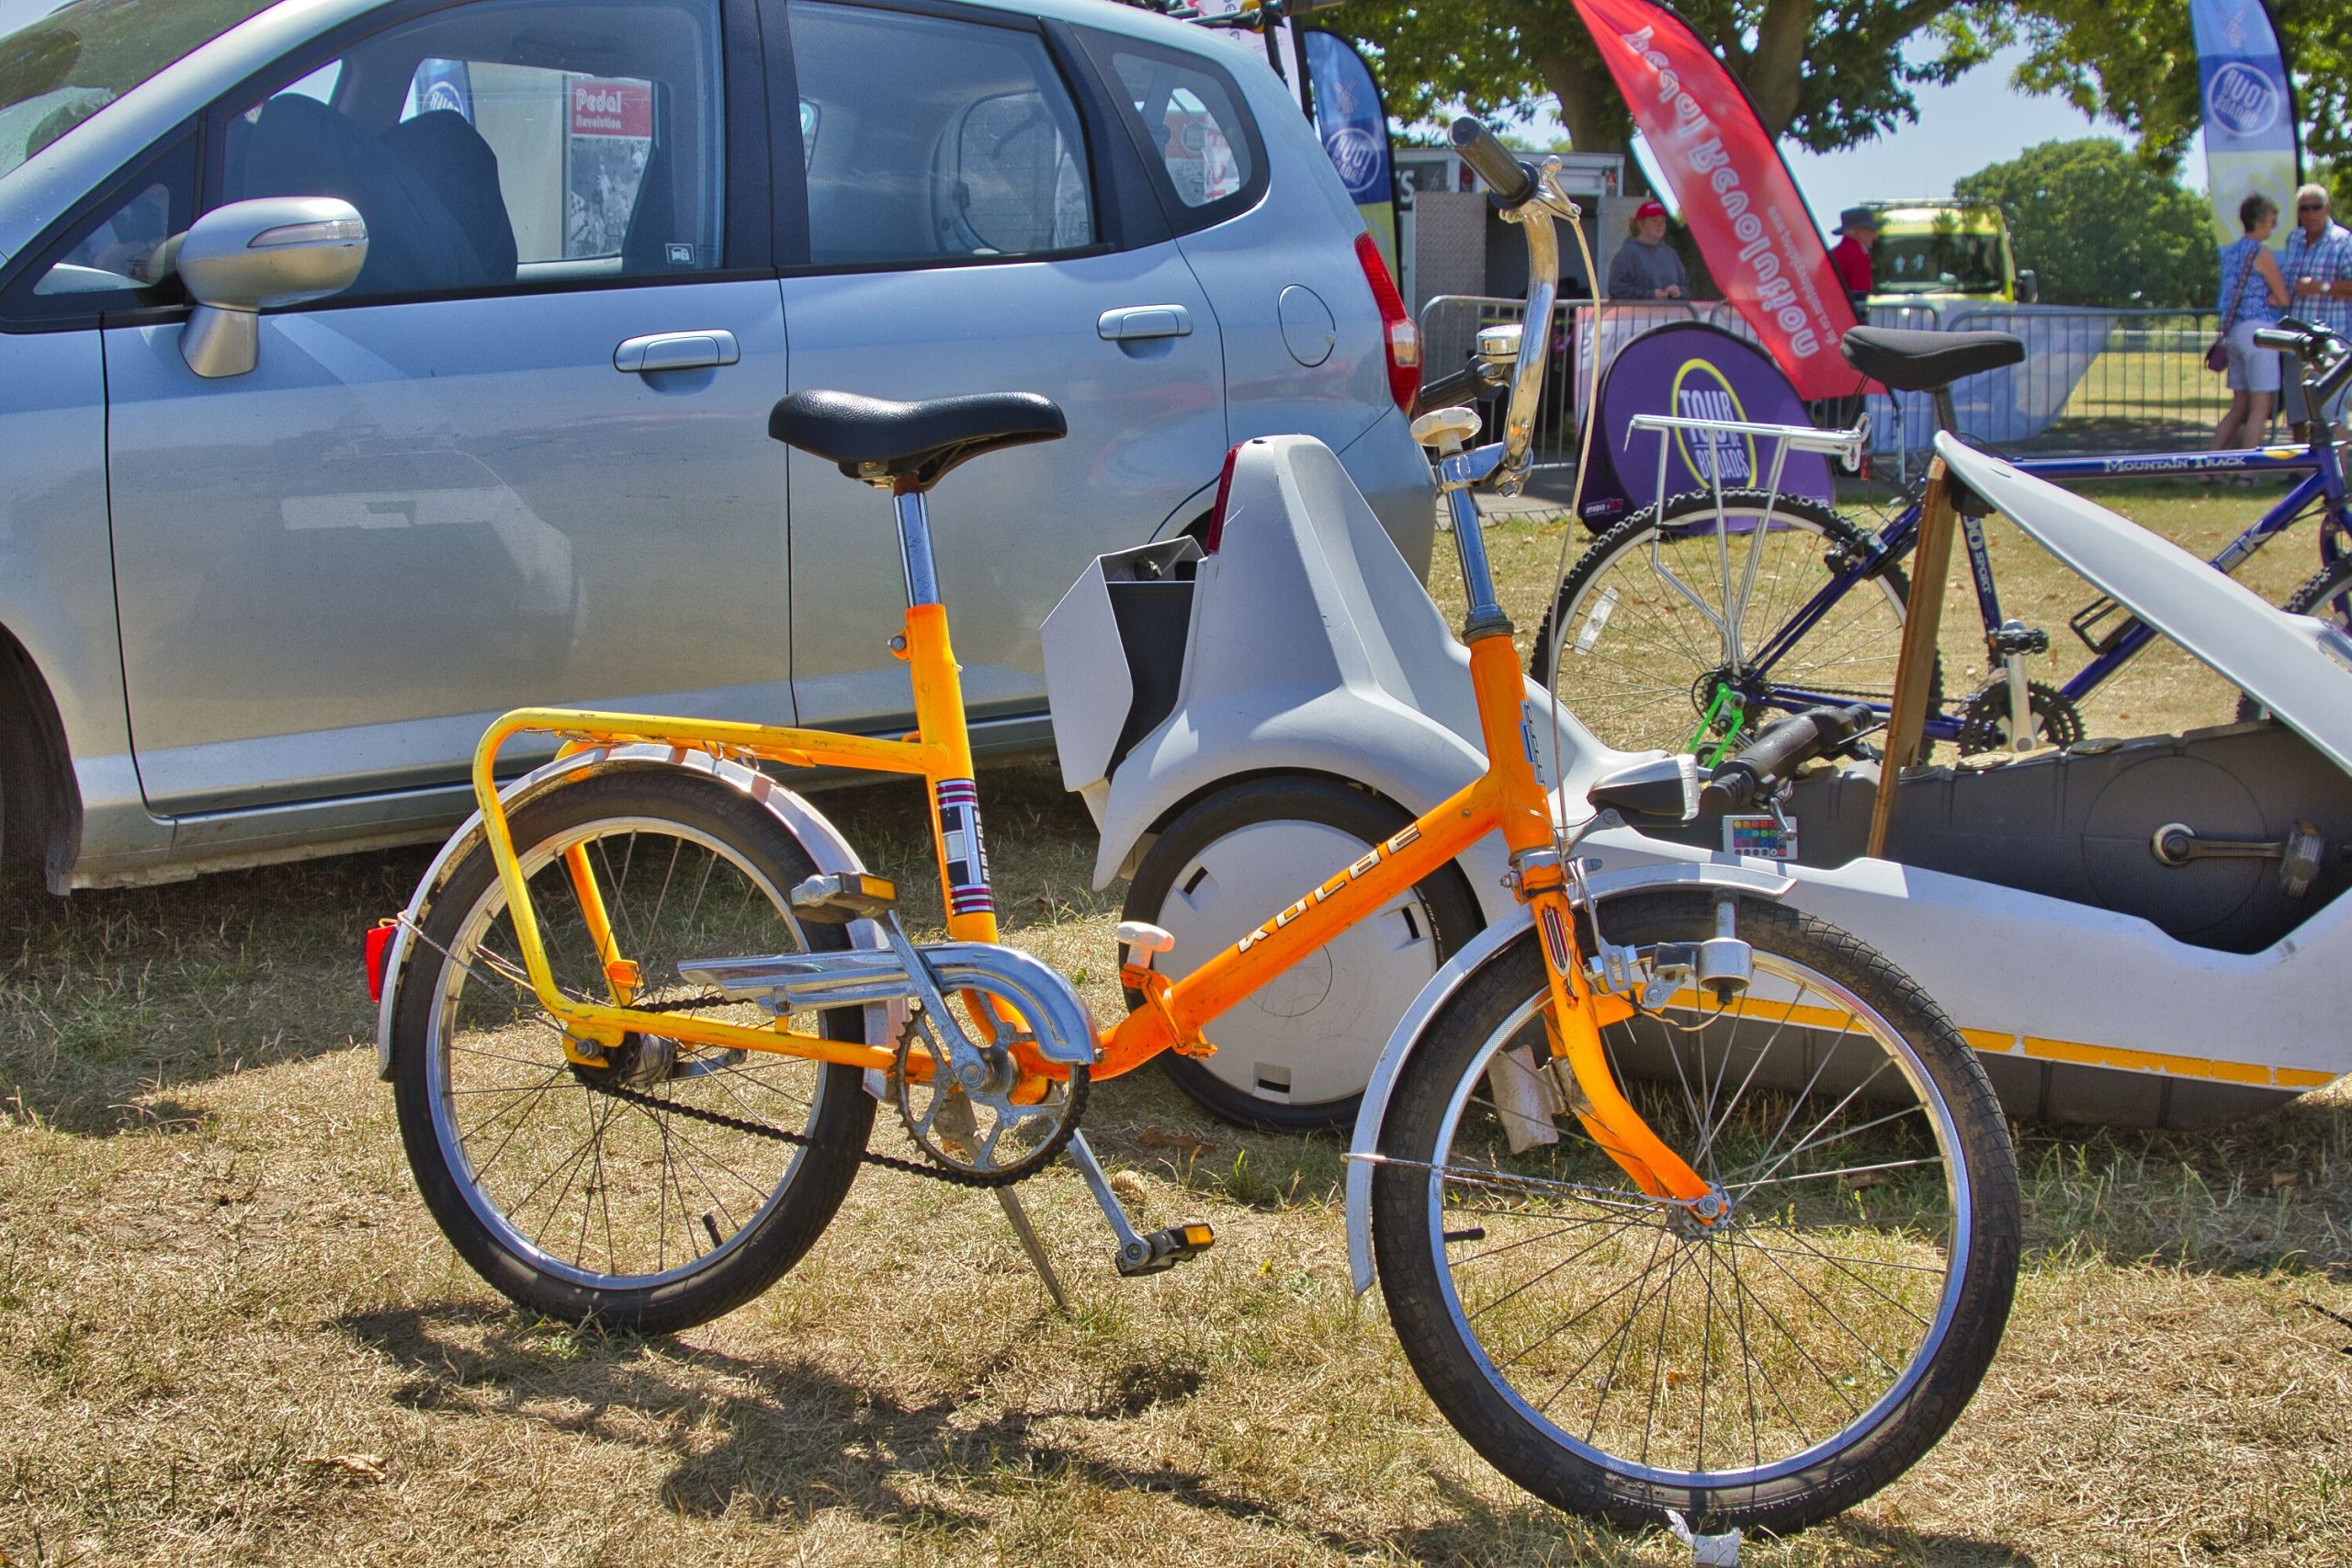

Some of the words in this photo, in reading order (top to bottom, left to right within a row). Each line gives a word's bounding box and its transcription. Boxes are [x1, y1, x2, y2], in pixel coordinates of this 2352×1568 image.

[575, 87, 622, 114] Pedal
[575, 114, 622, 130] Revolution
[1679, 389, 1736, 444] TOUR
[1975, 551, 1992, 593] SPORT
[974, 809, 990, 882] KOLBE
[1237, 822, 1422, 954] KOLBE
